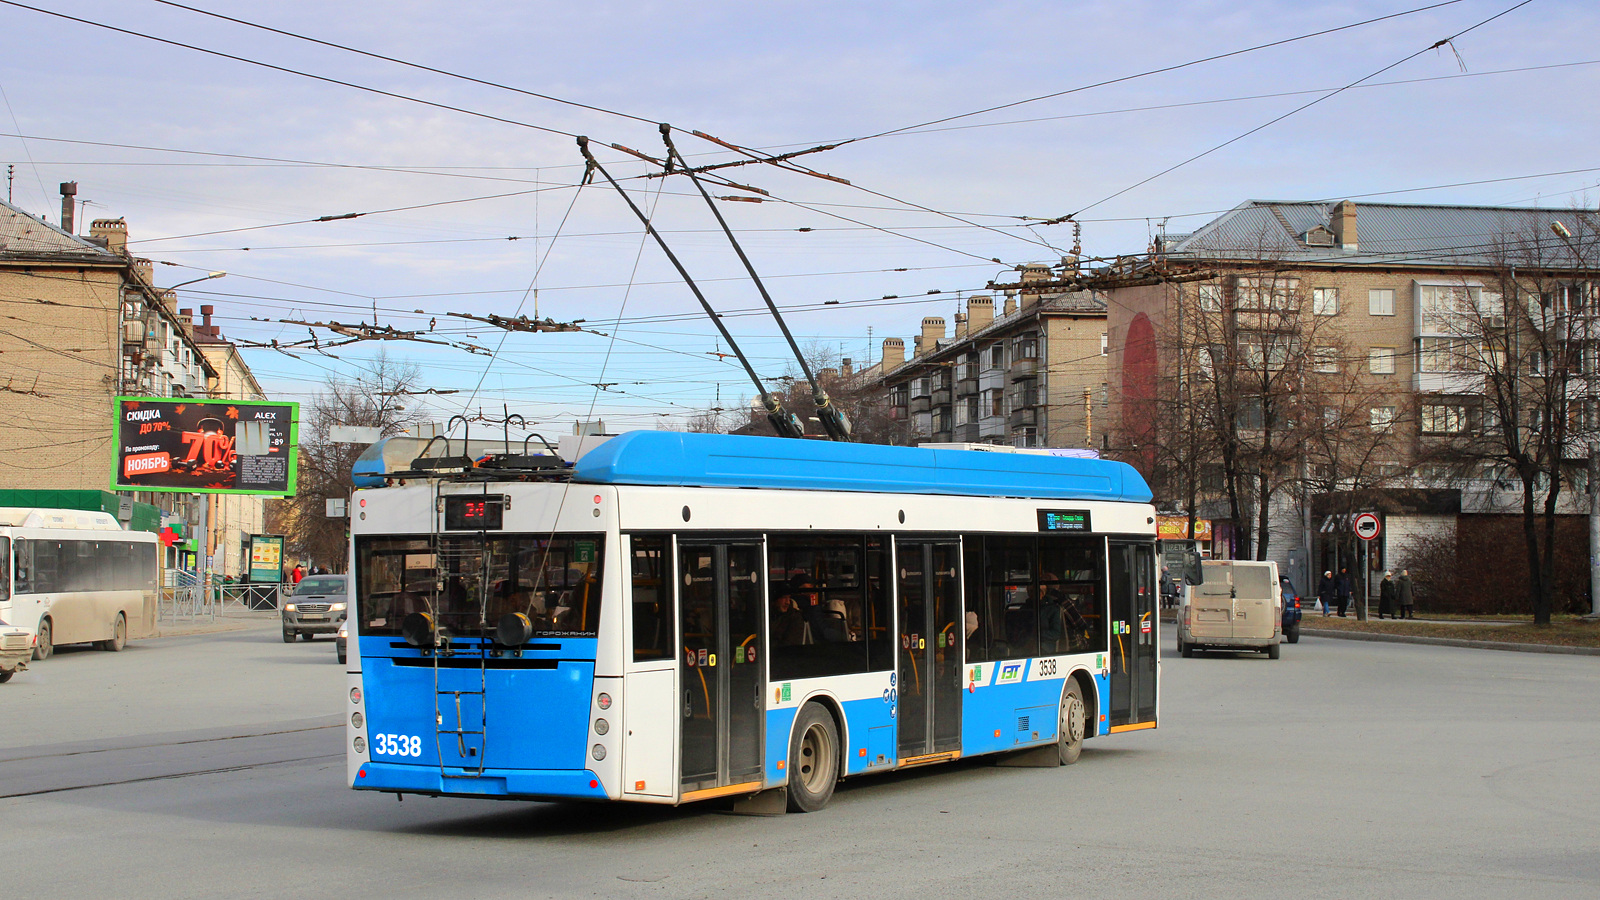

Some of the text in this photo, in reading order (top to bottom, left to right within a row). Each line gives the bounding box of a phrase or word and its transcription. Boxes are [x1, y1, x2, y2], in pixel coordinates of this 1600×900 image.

[126, 409, 161, 421] СКИДКА
[254, 412, 277, 420] ALEX
[139, 421, 172, 435] ДО 70%
[127, 456, 168, 471] НОЯБРЬ
[1039, 658, 1057, 676] 3538
[375, 732, 422, 757] 3538
